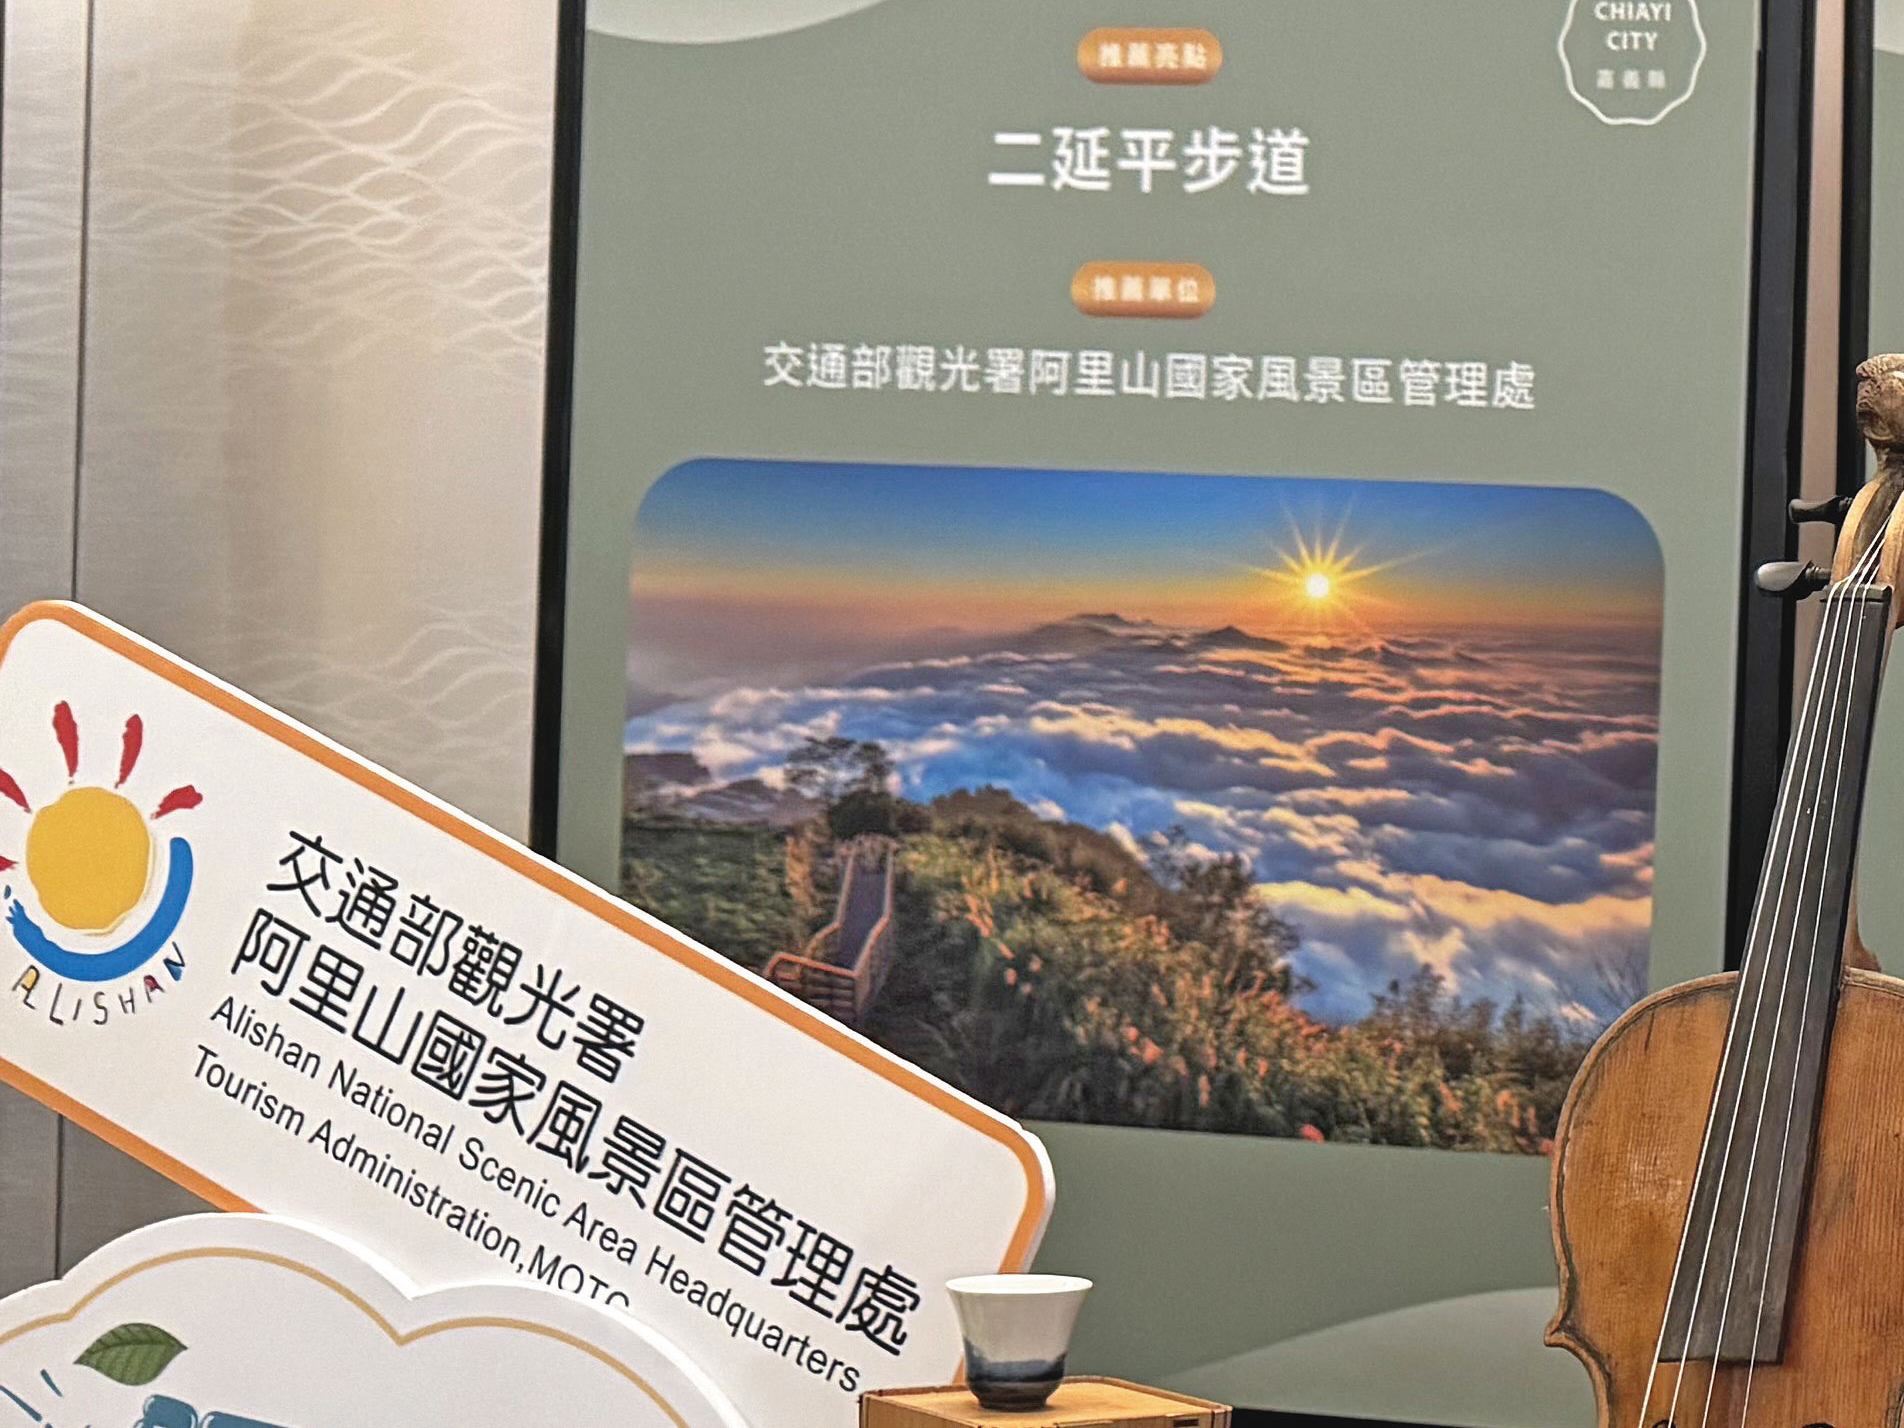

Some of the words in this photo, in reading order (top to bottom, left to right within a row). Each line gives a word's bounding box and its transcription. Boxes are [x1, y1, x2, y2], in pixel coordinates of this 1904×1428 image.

[1594, 1, 1671, 21] CHIAYI
[1606, 31, 1657, 50] CITY
[987, 126, 1310, 196] 二延平步道
[762, 341, 1537, 412] 交通部觀光署阿里山國家風景區管理處
[12, 941, 185, 1025] ALISHAN
[265, 828, 646, 1086] 交通部觀光署
[192, 1044, 306, 1136] Tourism
[230, 909, 922, 1360] 阿里山國家風景區管理處
[210, 996, 321, 1079] Alishan
[327, 1059, 455, 1155] National
[458, 1137, 562, 1217] Scenic
[563, 1202, 638, 1265] Area
[644, 1245, 862, 1394] Headquarters
